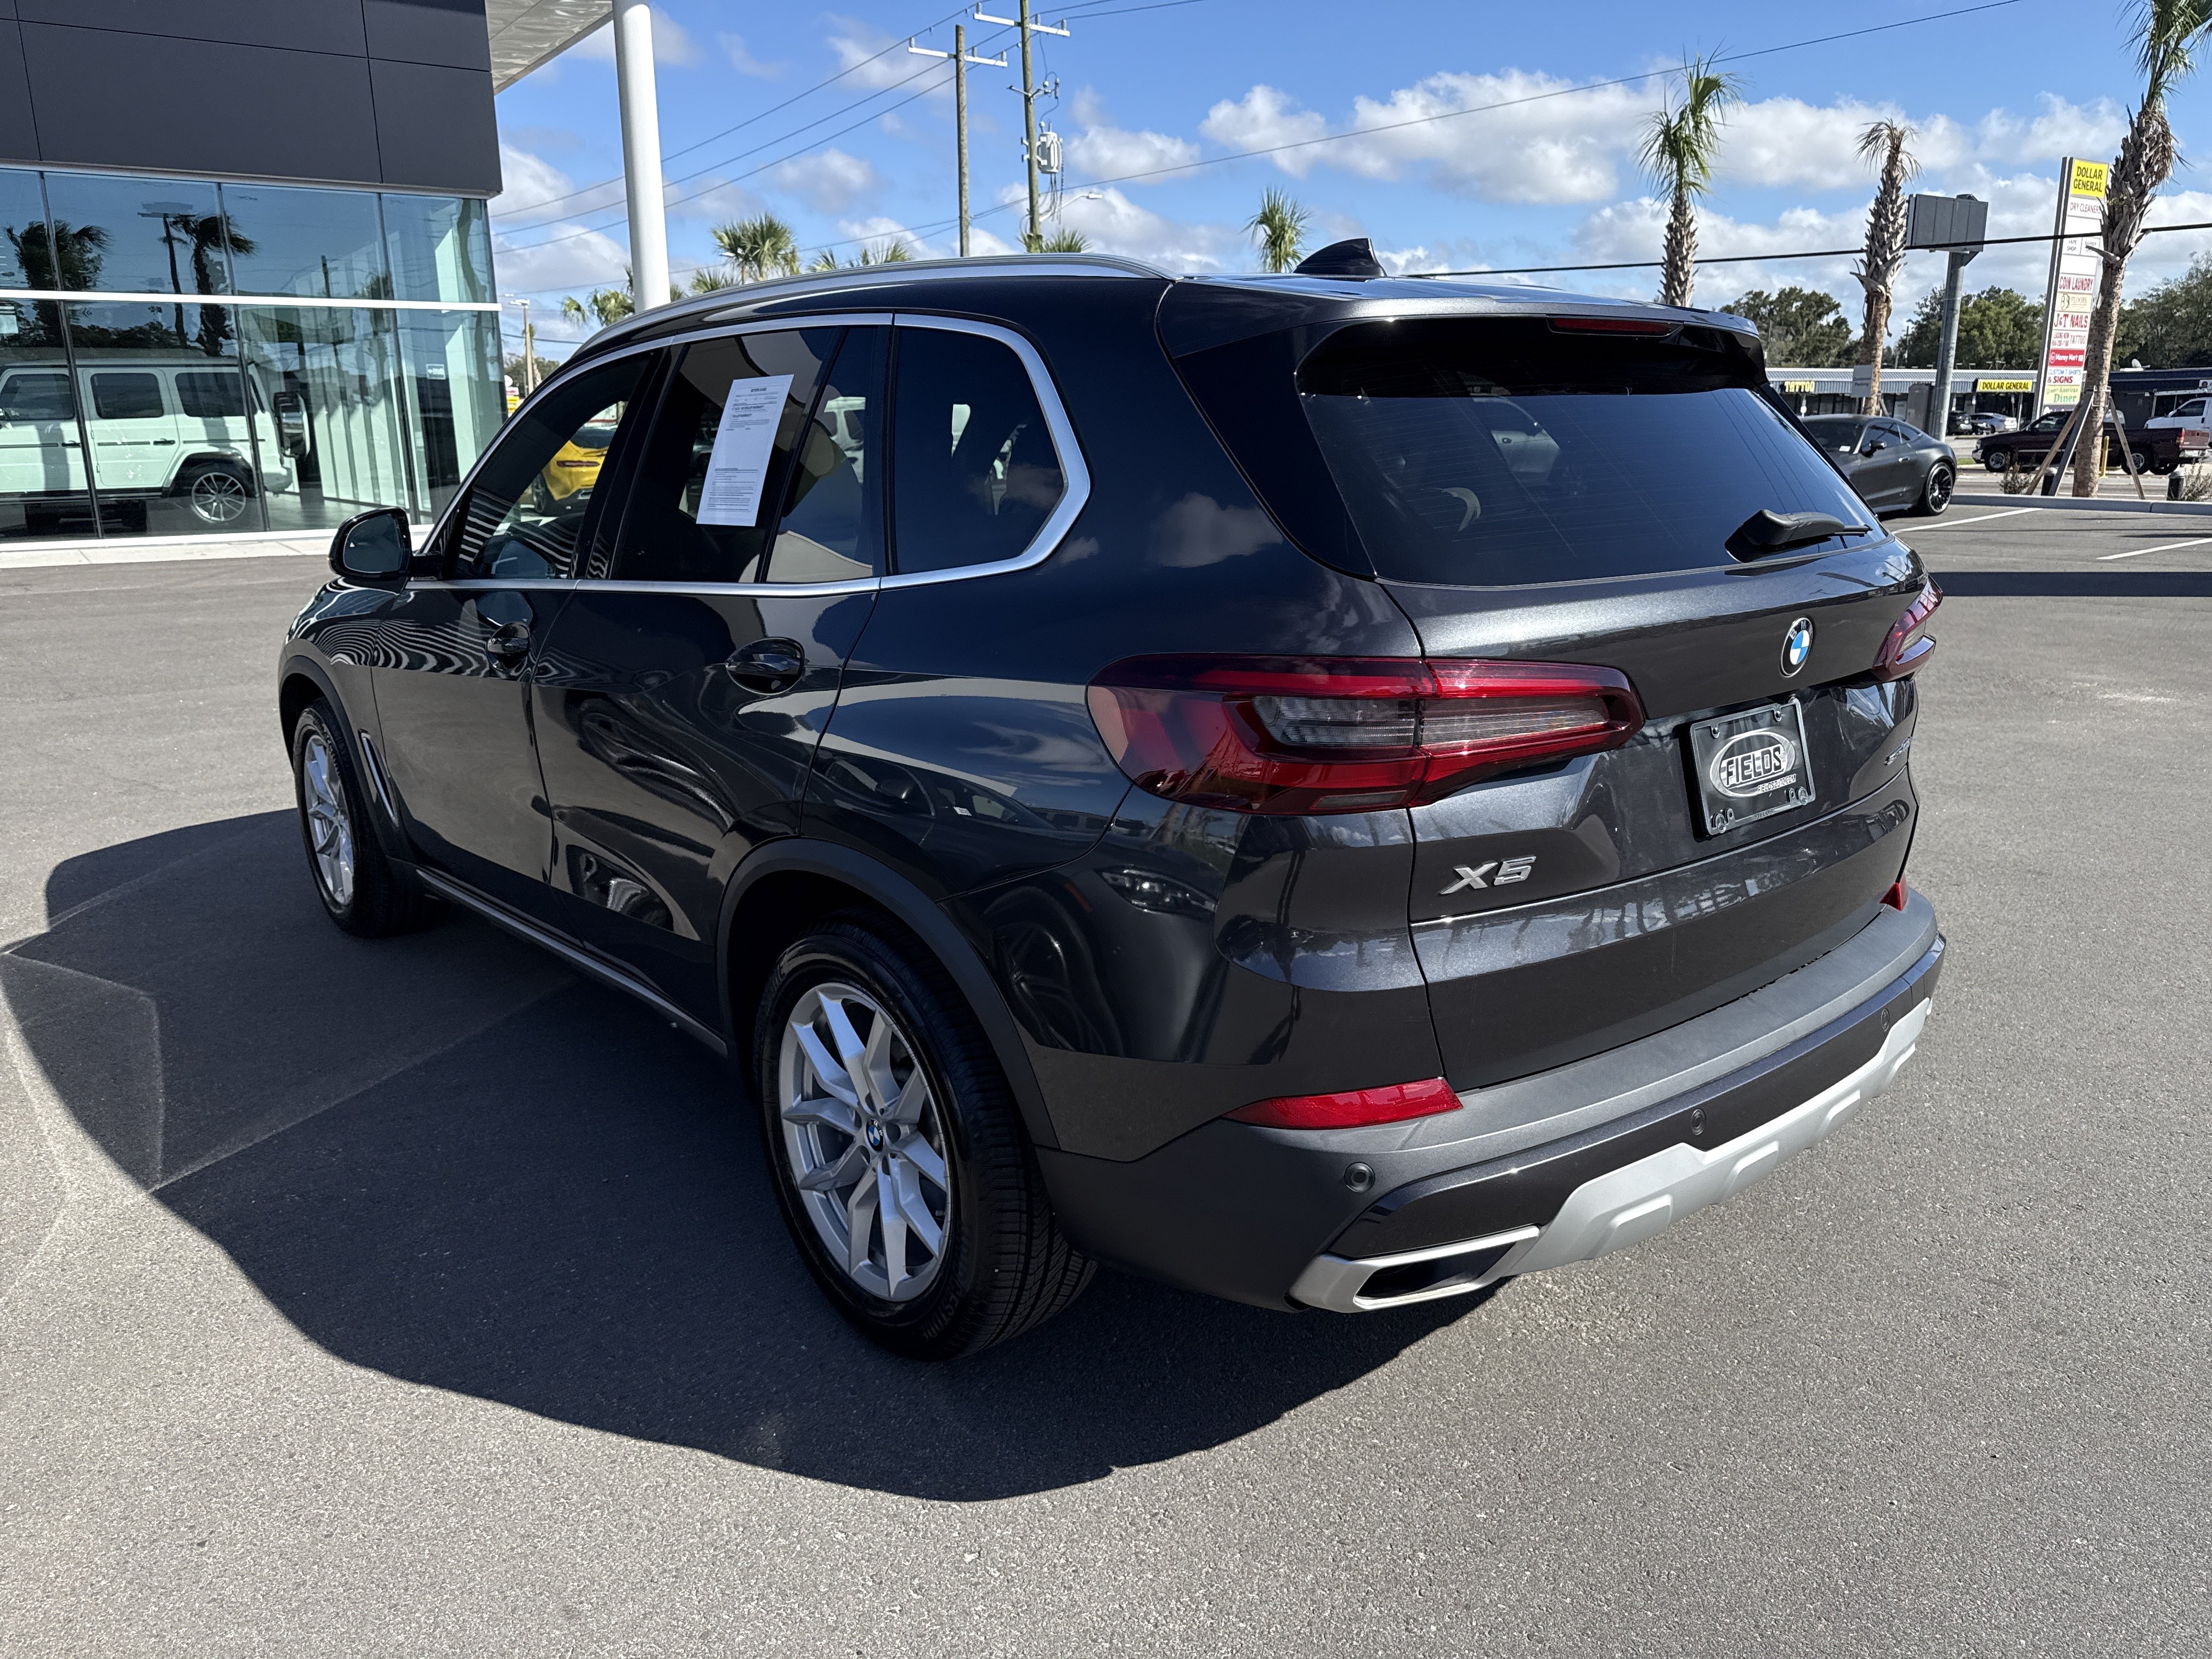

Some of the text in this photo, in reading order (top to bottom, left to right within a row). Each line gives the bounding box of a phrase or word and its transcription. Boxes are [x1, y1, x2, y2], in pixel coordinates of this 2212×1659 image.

[2076, 166, 2103, 180] DOLLAR
[2073, 178, 2102, 192] GENERAL
[2070, 202, 2079, 211] DRY
[2059, 276, 2094, 291] COIN LAUNDRY
[2054, 314, 2089, 328] J&T NAILS
[2070, 335, 2086, 345] TATTOO
[2056, 353, 2069, 363] Money
[1784, 381, 1815, 392] TATTOO
[1982, 381, 2029, 390] DOLLAR GENERAL
[2053, 393, 2077, 402] Diner
[1726, 746, 1782, 787] FIELDS
[1439, 854, 1537, 895] X5
